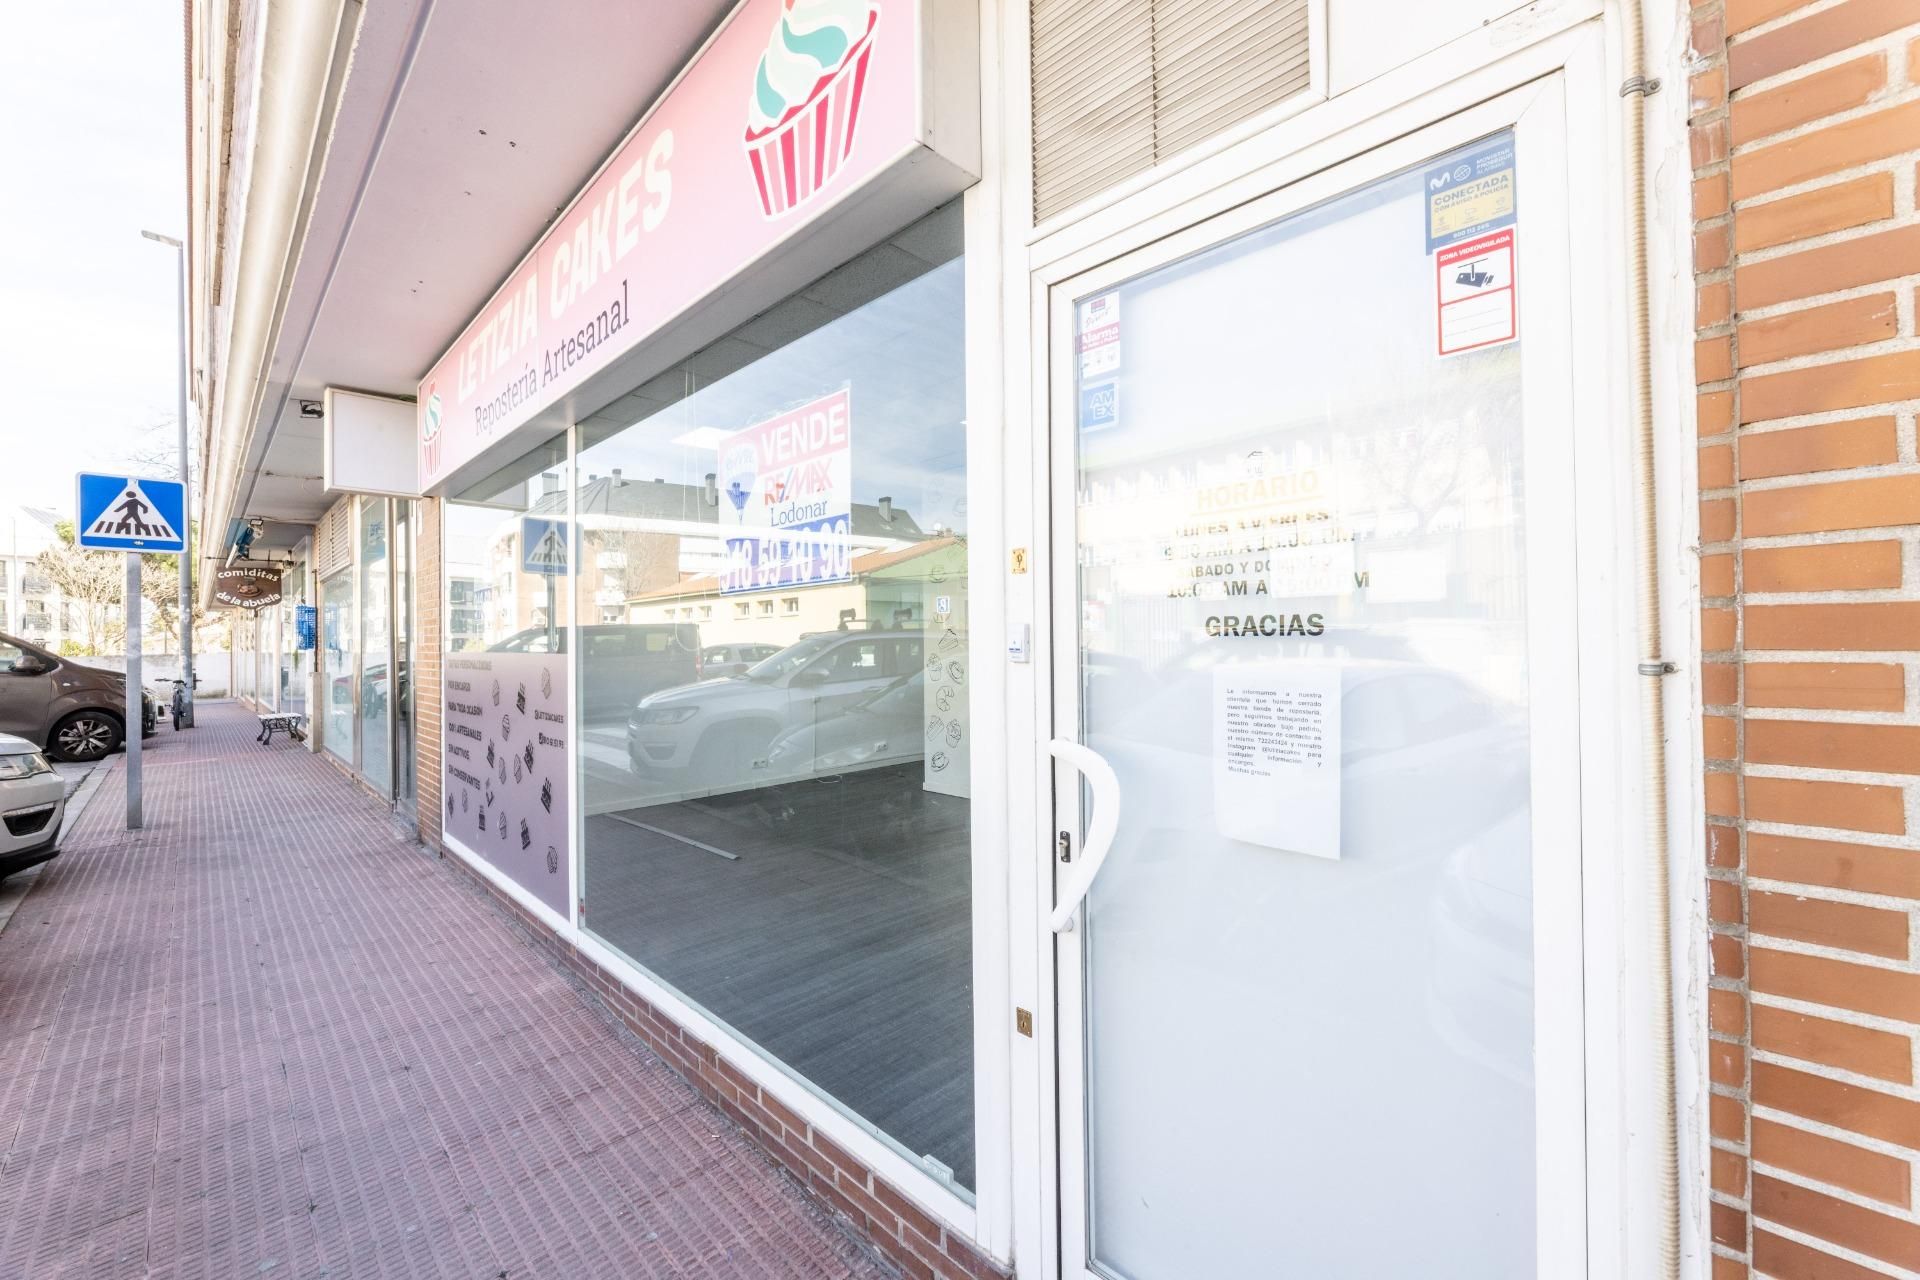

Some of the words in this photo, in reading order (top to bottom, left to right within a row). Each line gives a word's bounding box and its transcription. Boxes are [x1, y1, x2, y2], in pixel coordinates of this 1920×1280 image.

[1433, 173, 1510, 206] CONECTADA
[1451, 195, 1473, 208] AVISO
[1439, 251, 1459, 262] ZONA
[1458, 235, 1511, 257] VIDEOVIGILADA
[457, 272, 539, 401] LETIZIA
[549, 128, 675, 321] CAKES
[1082, 325, 1119, 344] Alarma
[474, 362, 538, 437] Repostería
[541, 278, 630, 389] Artesanal
[1090, 389, 1115, 408] AM
[761, 402, 846, 466] VENDE
[763, 457, 834, 506] RE/MAX
[1197, 469, 1319, 508] HORARIO
[770, 500, 828, 527] Lodonar
[820, 518, 850, 580] 90
[218, 567, 280, 583] comiditas
[1181, 562, 1234, 578] BADO
[1239, 561, 1249, 574] Y
[216, 591, 231, 602] de
[230, 596, 241, 606] la
[242, 592, 281, 608] abuela
[1255, 579, 1268, 596] A
[1205, 613, 1325, 638] GRACIAS
